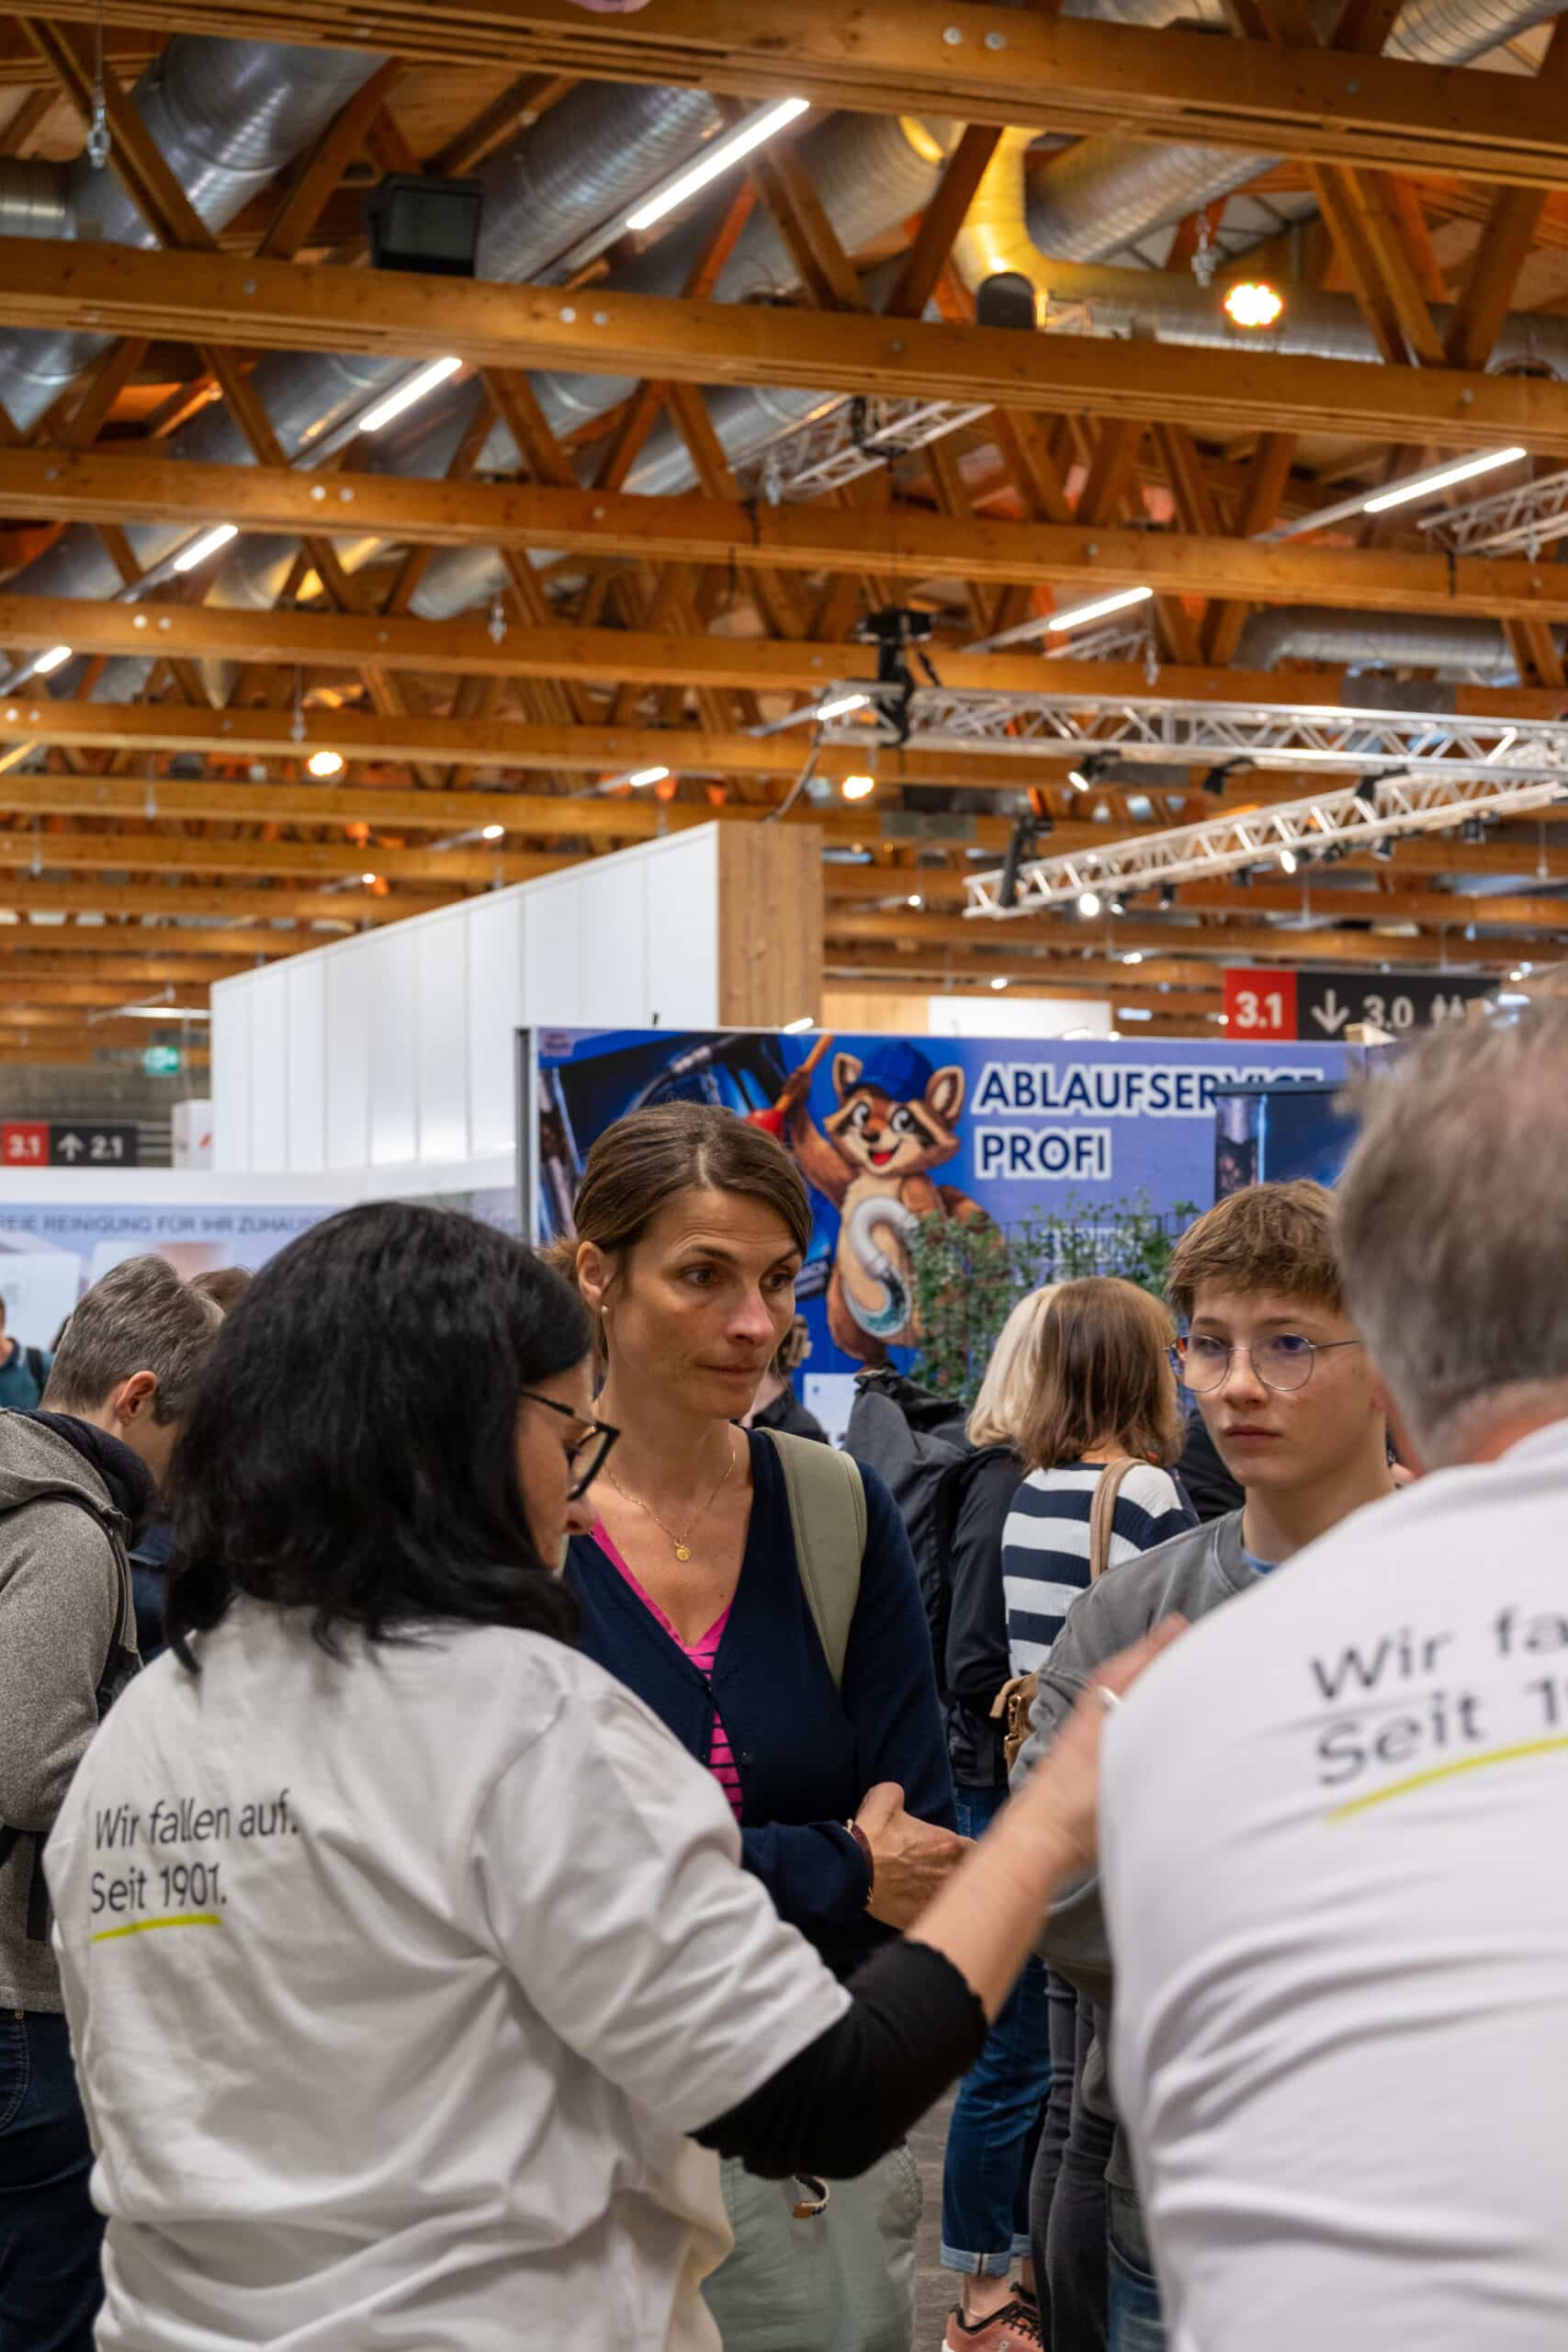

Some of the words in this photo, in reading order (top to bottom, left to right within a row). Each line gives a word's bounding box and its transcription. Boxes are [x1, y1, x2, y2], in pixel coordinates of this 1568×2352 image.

[1235, 989, 1284, 1029] 3.1
[1361, 994, 1416, 1030] 3.0
[977, 1069, 1319, 1111] ABLAUFSER
[7, 1133, 41, 1159] 3.1
[90, 1134, 124, 1159] 2.1
[980, 1132, 1108, 1174] PROFI
[1309, 1622, 1459, 1700] Wir
[1314, 1689, 1485, 1787] Seit
[1524, 1674, 1568, 1727] 1
[95, 1804, 140, 1850] Wir
[149, 1797, 230, 1846] fallen
[238, 1787, 299, 1838] auf.
[91, 1866, 148, 1914] Seit
[159, 1861, 228, 1908] 1901.
